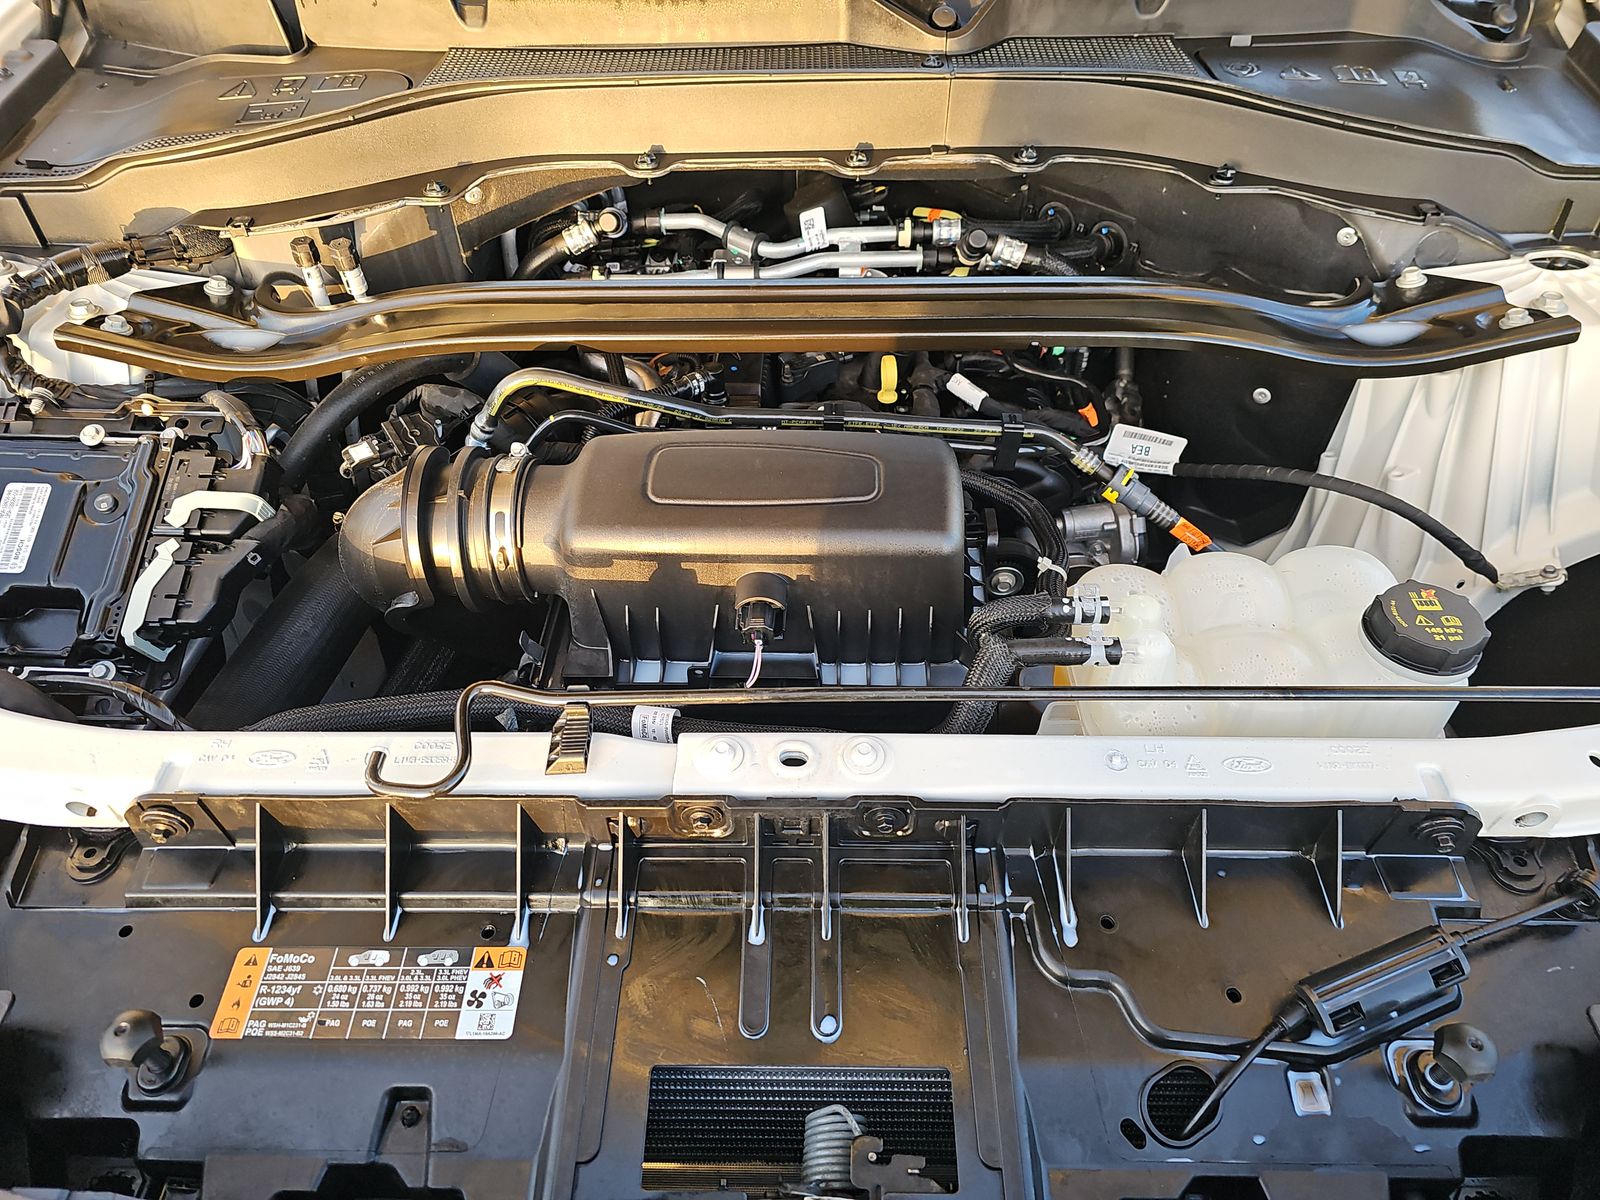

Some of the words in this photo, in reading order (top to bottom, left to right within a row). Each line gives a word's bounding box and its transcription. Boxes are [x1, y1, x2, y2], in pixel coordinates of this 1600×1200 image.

[1131, 444, 1151, 456] BEA
[270, 954, 316, 964] FoMoCo
[260, 985, 302, 995] R-1234yf
[348, 985, 358, 994] kg
[383, 985, 392, 994] kg
[420, 985, 429, 994] kg
[455, 985, 464, 994] kg
[255, 998, 284, 1007] (GWP
[284, 998, 294, 1007] 4)
